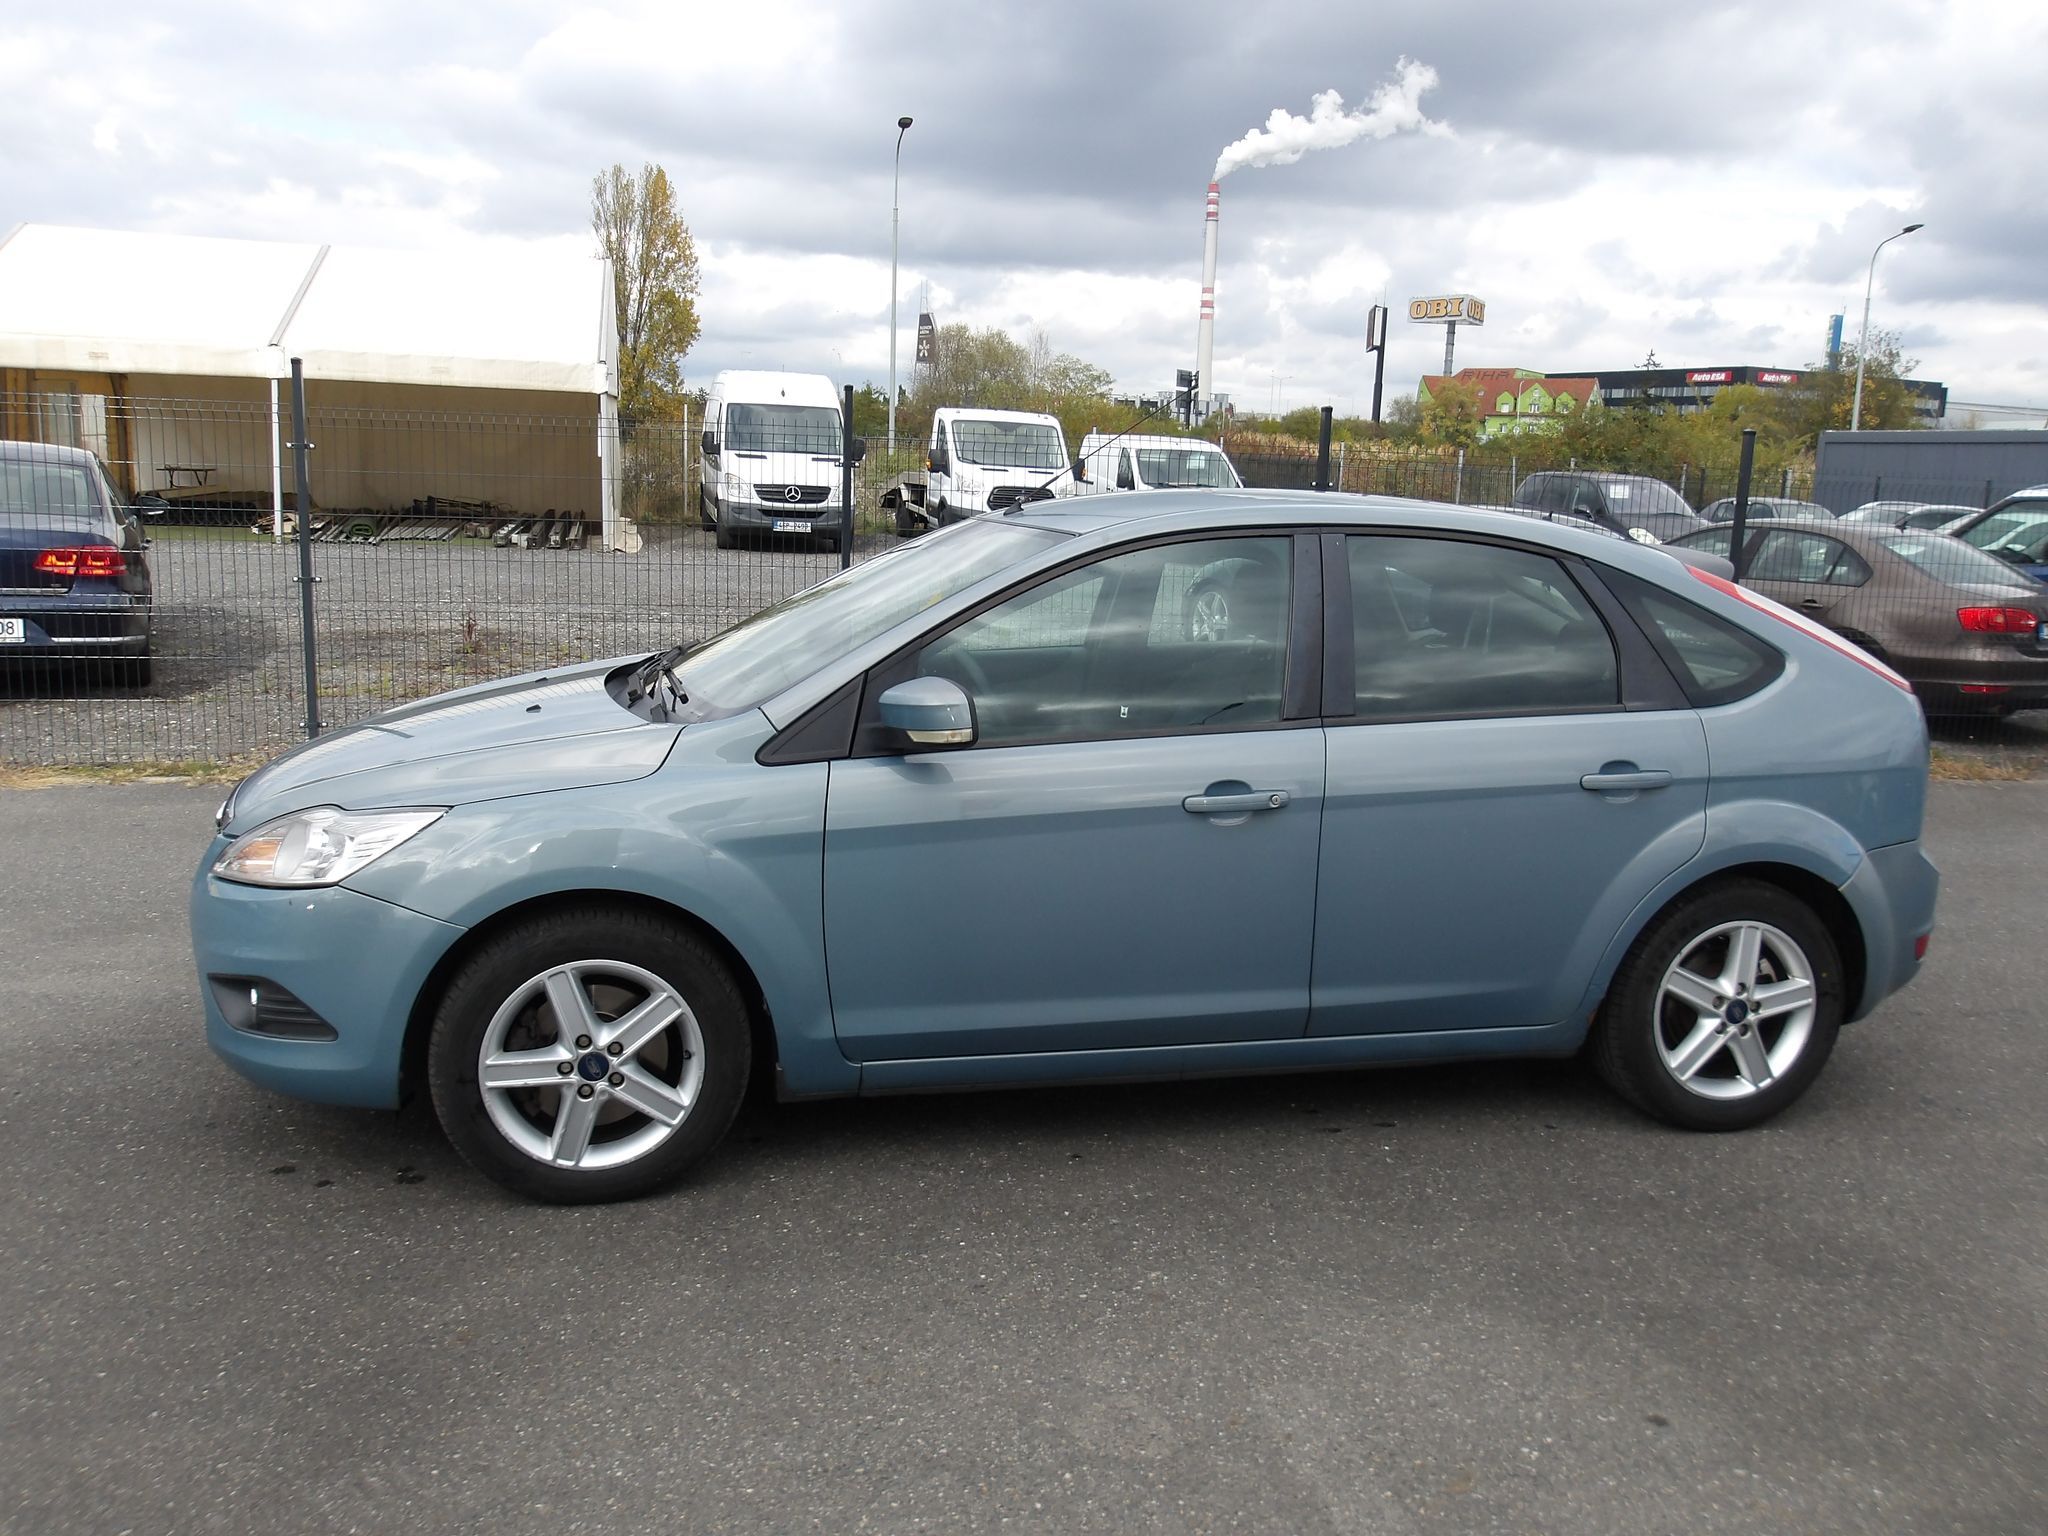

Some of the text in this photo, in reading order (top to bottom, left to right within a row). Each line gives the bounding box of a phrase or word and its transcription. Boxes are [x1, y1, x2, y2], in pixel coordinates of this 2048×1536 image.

[1410, 298, 1464, 319] OBI
[1467, 299, 1485, 322] OBI
[1692, 373, 1711, 381] Auto
